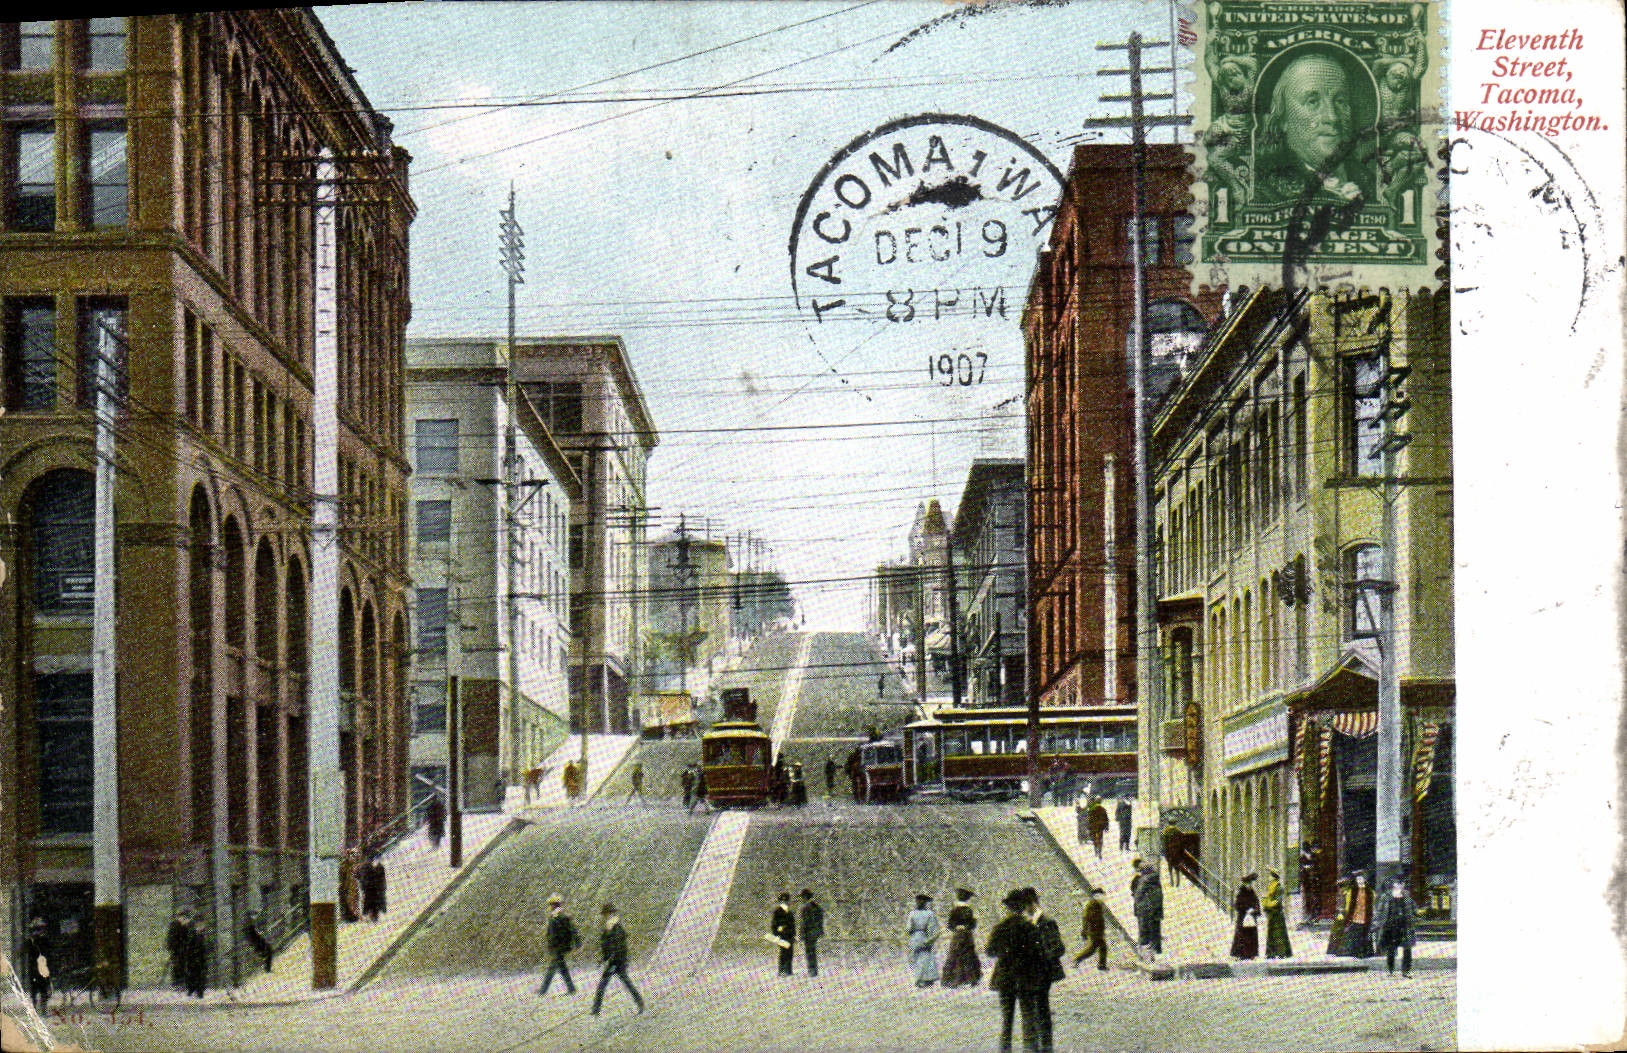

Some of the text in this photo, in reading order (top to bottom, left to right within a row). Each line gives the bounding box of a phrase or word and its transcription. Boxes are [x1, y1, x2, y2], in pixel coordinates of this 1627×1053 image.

[1224, 11, 1409, 24] UNITED STATES OF
[1266, 30, 1374, 49] AMERICA
[1214, 187, 1229, 224] 1
[1244, 213, 1272, 224] 1706
[1359, 213, 1387, 224] 1790
[1401, 189, 1416, 225] 1
[806, 134, 954, 324] TACOMA
[886, 287, 916, 323] 8
[928, 352, 988, 387] 1907
